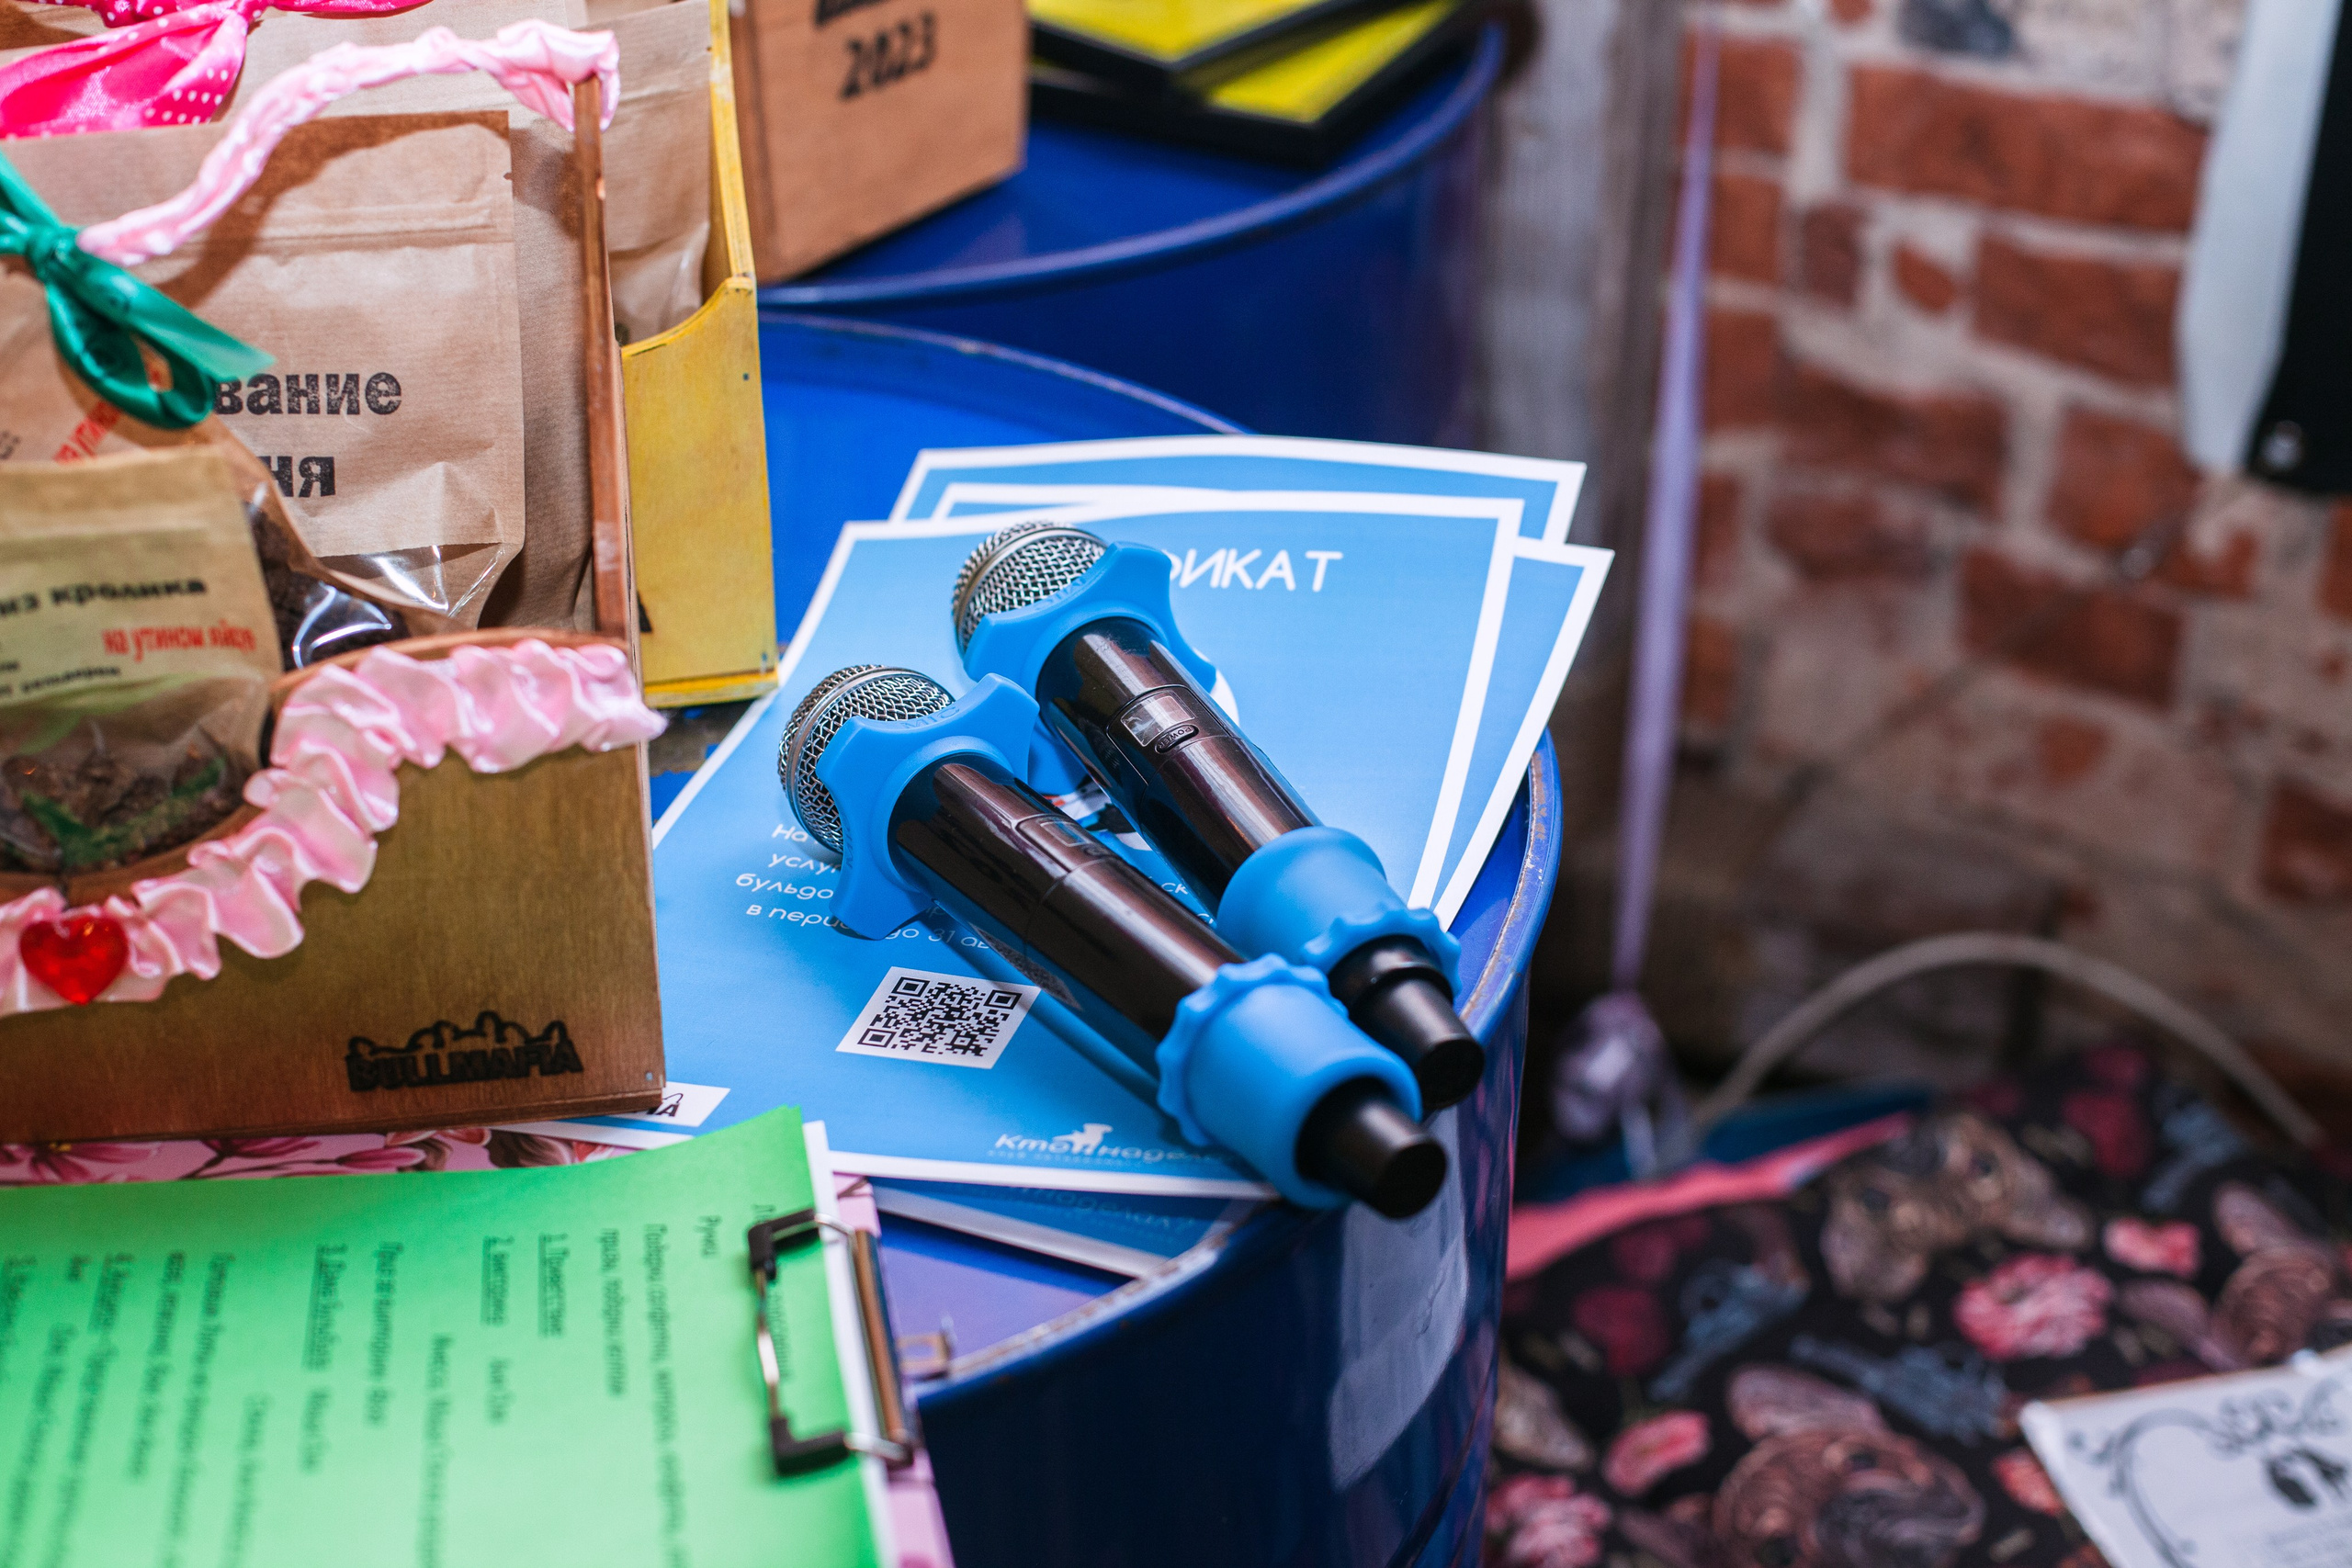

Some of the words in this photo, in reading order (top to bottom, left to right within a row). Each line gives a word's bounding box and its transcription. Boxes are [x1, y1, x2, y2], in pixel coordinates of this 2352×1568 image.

[840, 11, 937, 101] 2023
[216, 371, 401, 415] вание
[258, 456, 336, 498] ня
[1170, 548, 1343, 593] ИКАТ
[1158, 725, 1193, 750] POWER
[772, 824, 808, 842] На
[735, 873, 834, 900] бульдо
[746, 904, 763, 916] в
